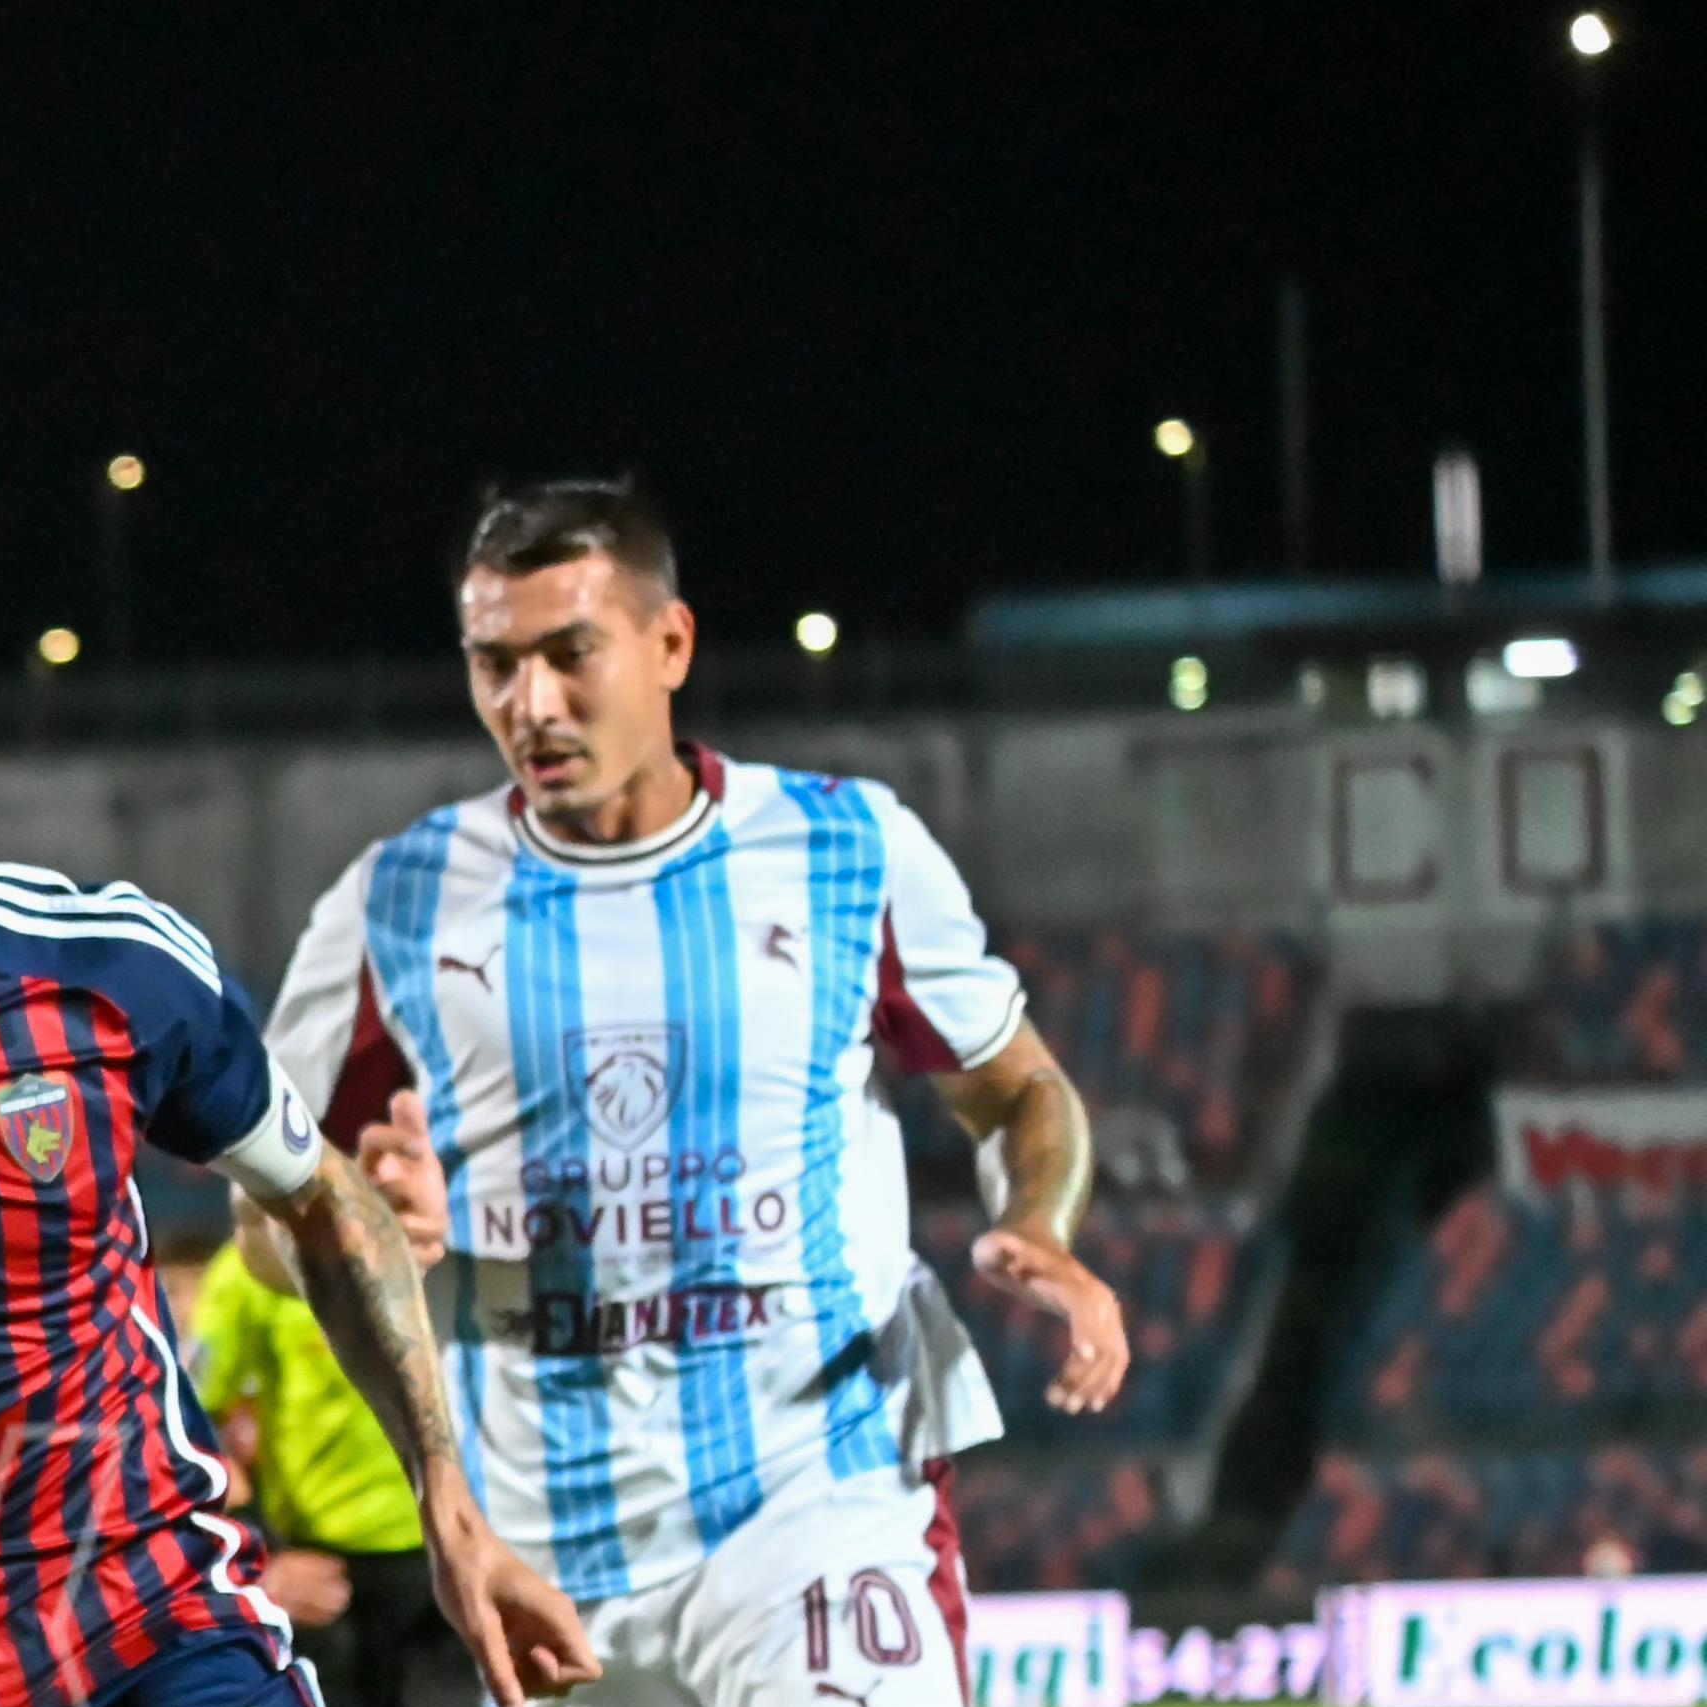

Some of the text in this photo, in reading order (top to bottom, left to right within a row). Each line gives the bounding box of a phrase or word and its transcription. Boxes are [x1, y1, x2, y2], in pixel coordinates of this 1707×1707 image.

[520, 1147, 746, 1193] GRUPPO
[483, 1191, 786, 1247] NOVIELLO
[803, 1567, 922, 1673] 10
